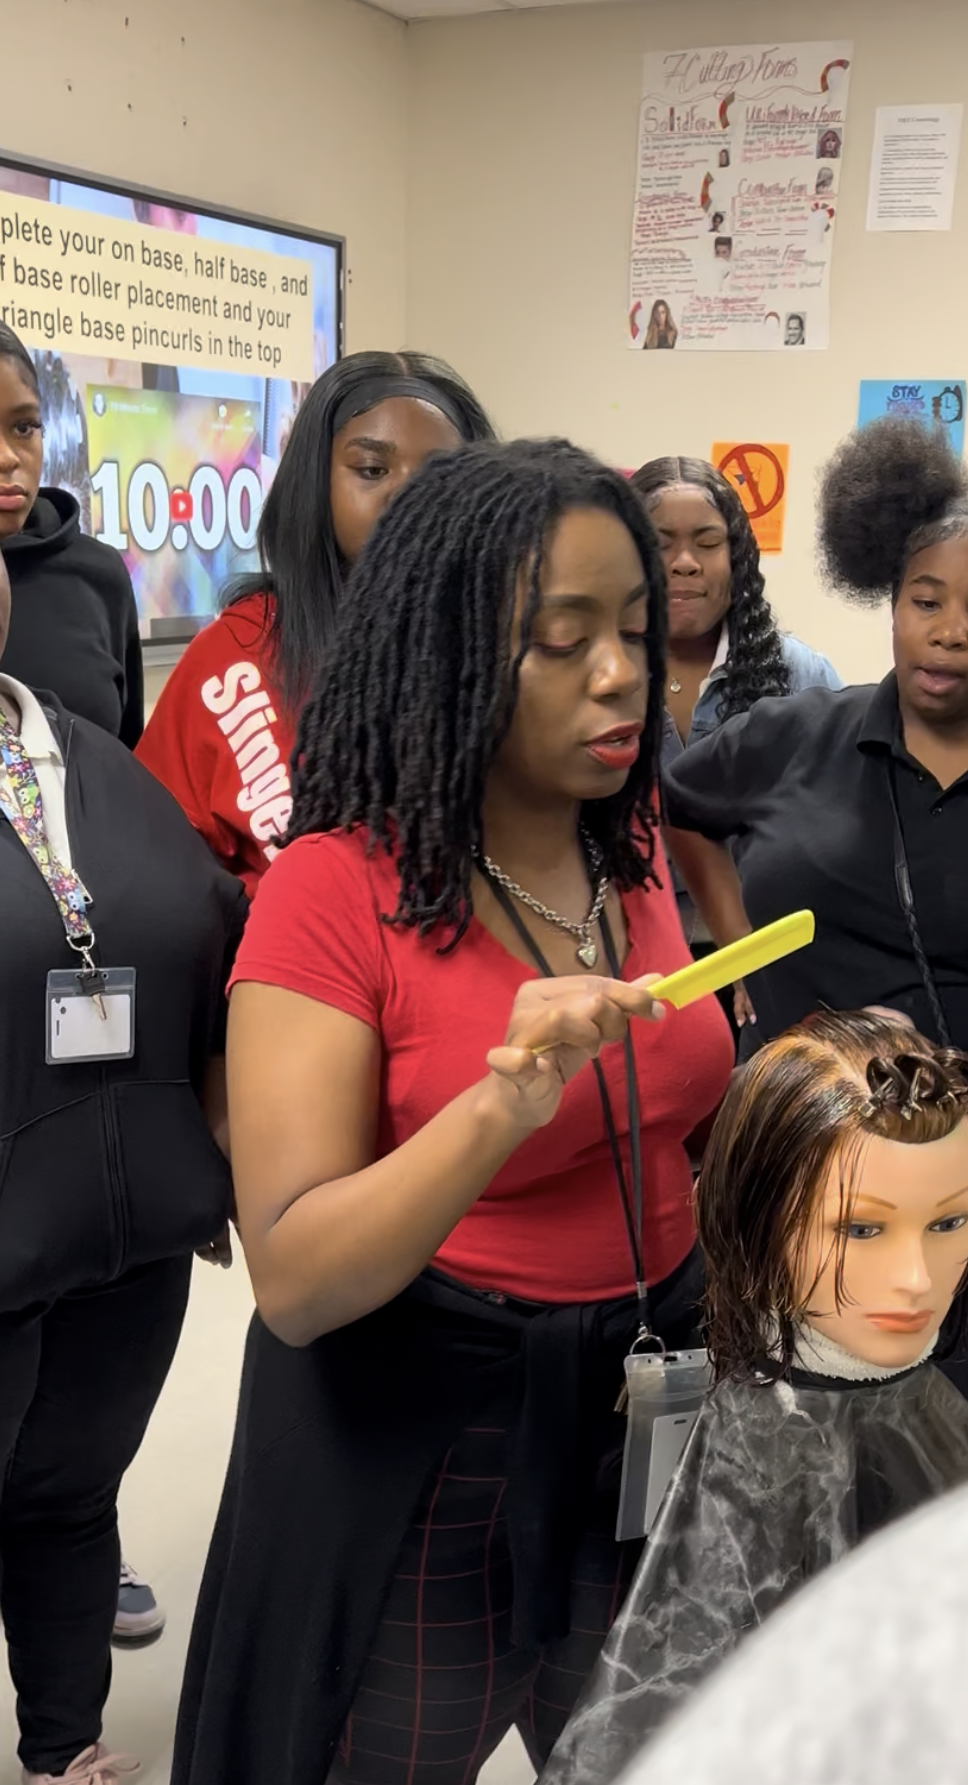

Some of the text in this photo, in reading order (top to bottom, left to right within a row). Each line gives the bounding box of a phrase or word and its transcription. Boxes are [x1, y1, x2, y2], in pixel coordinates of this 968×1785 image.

[1, 212, 52, 246] plete
[60, 229, 105, 257] your
[112, 240, 134, 262] on
[141, 240, 188, 278] base,
[194, 252, 225, 280] half
[230, 259, 267, 288] base
[281, 274, 308, 296] and
[14, 257, 63, 291] base
[71, 271, 121, 300] roller
[128, 280, 218, 317] placement
[223, 300, 252, 323] and
[257, 307, 291, 331] your
[2, 300, 282, 369] riangle base pincurls in the top
[892, 385, 922, 398] STAY
[201, 661, 294, 863] Slinge
